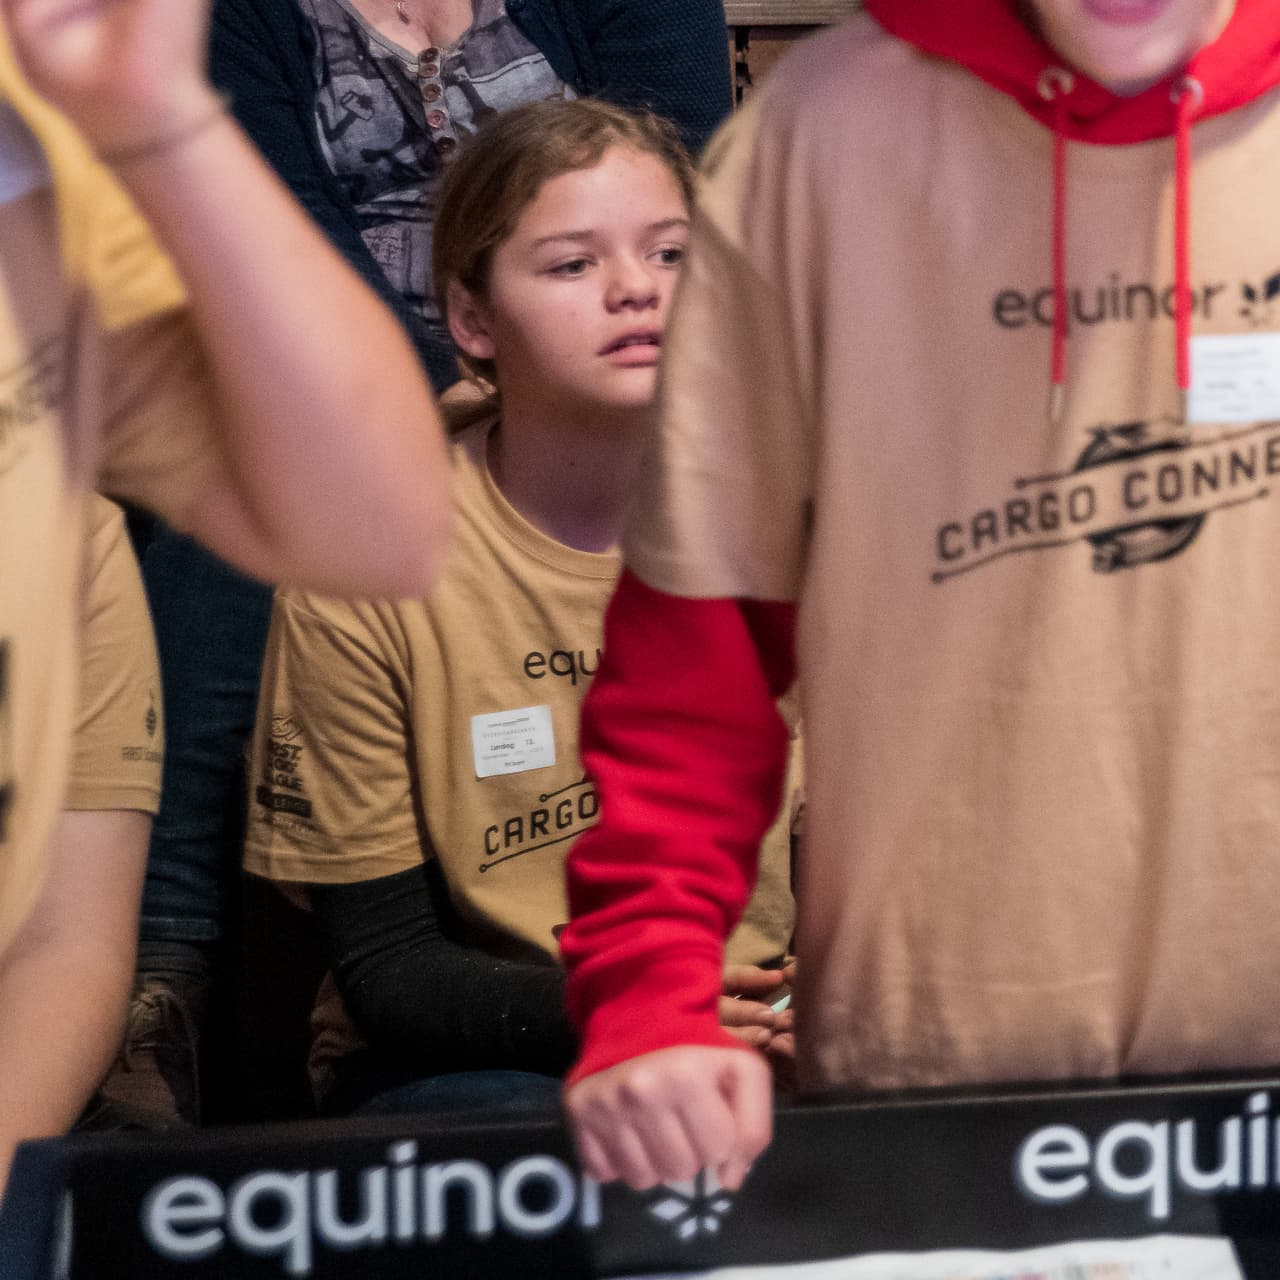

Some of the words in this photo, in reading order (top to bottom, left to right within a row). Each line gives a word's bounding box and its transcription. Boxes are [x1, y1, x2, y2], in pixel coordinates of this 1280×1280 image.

[992, 273, 1228, 341] equinor
[937, 486, 1097, 563] CARGO
[483, 790, 599, 857] CARGO
